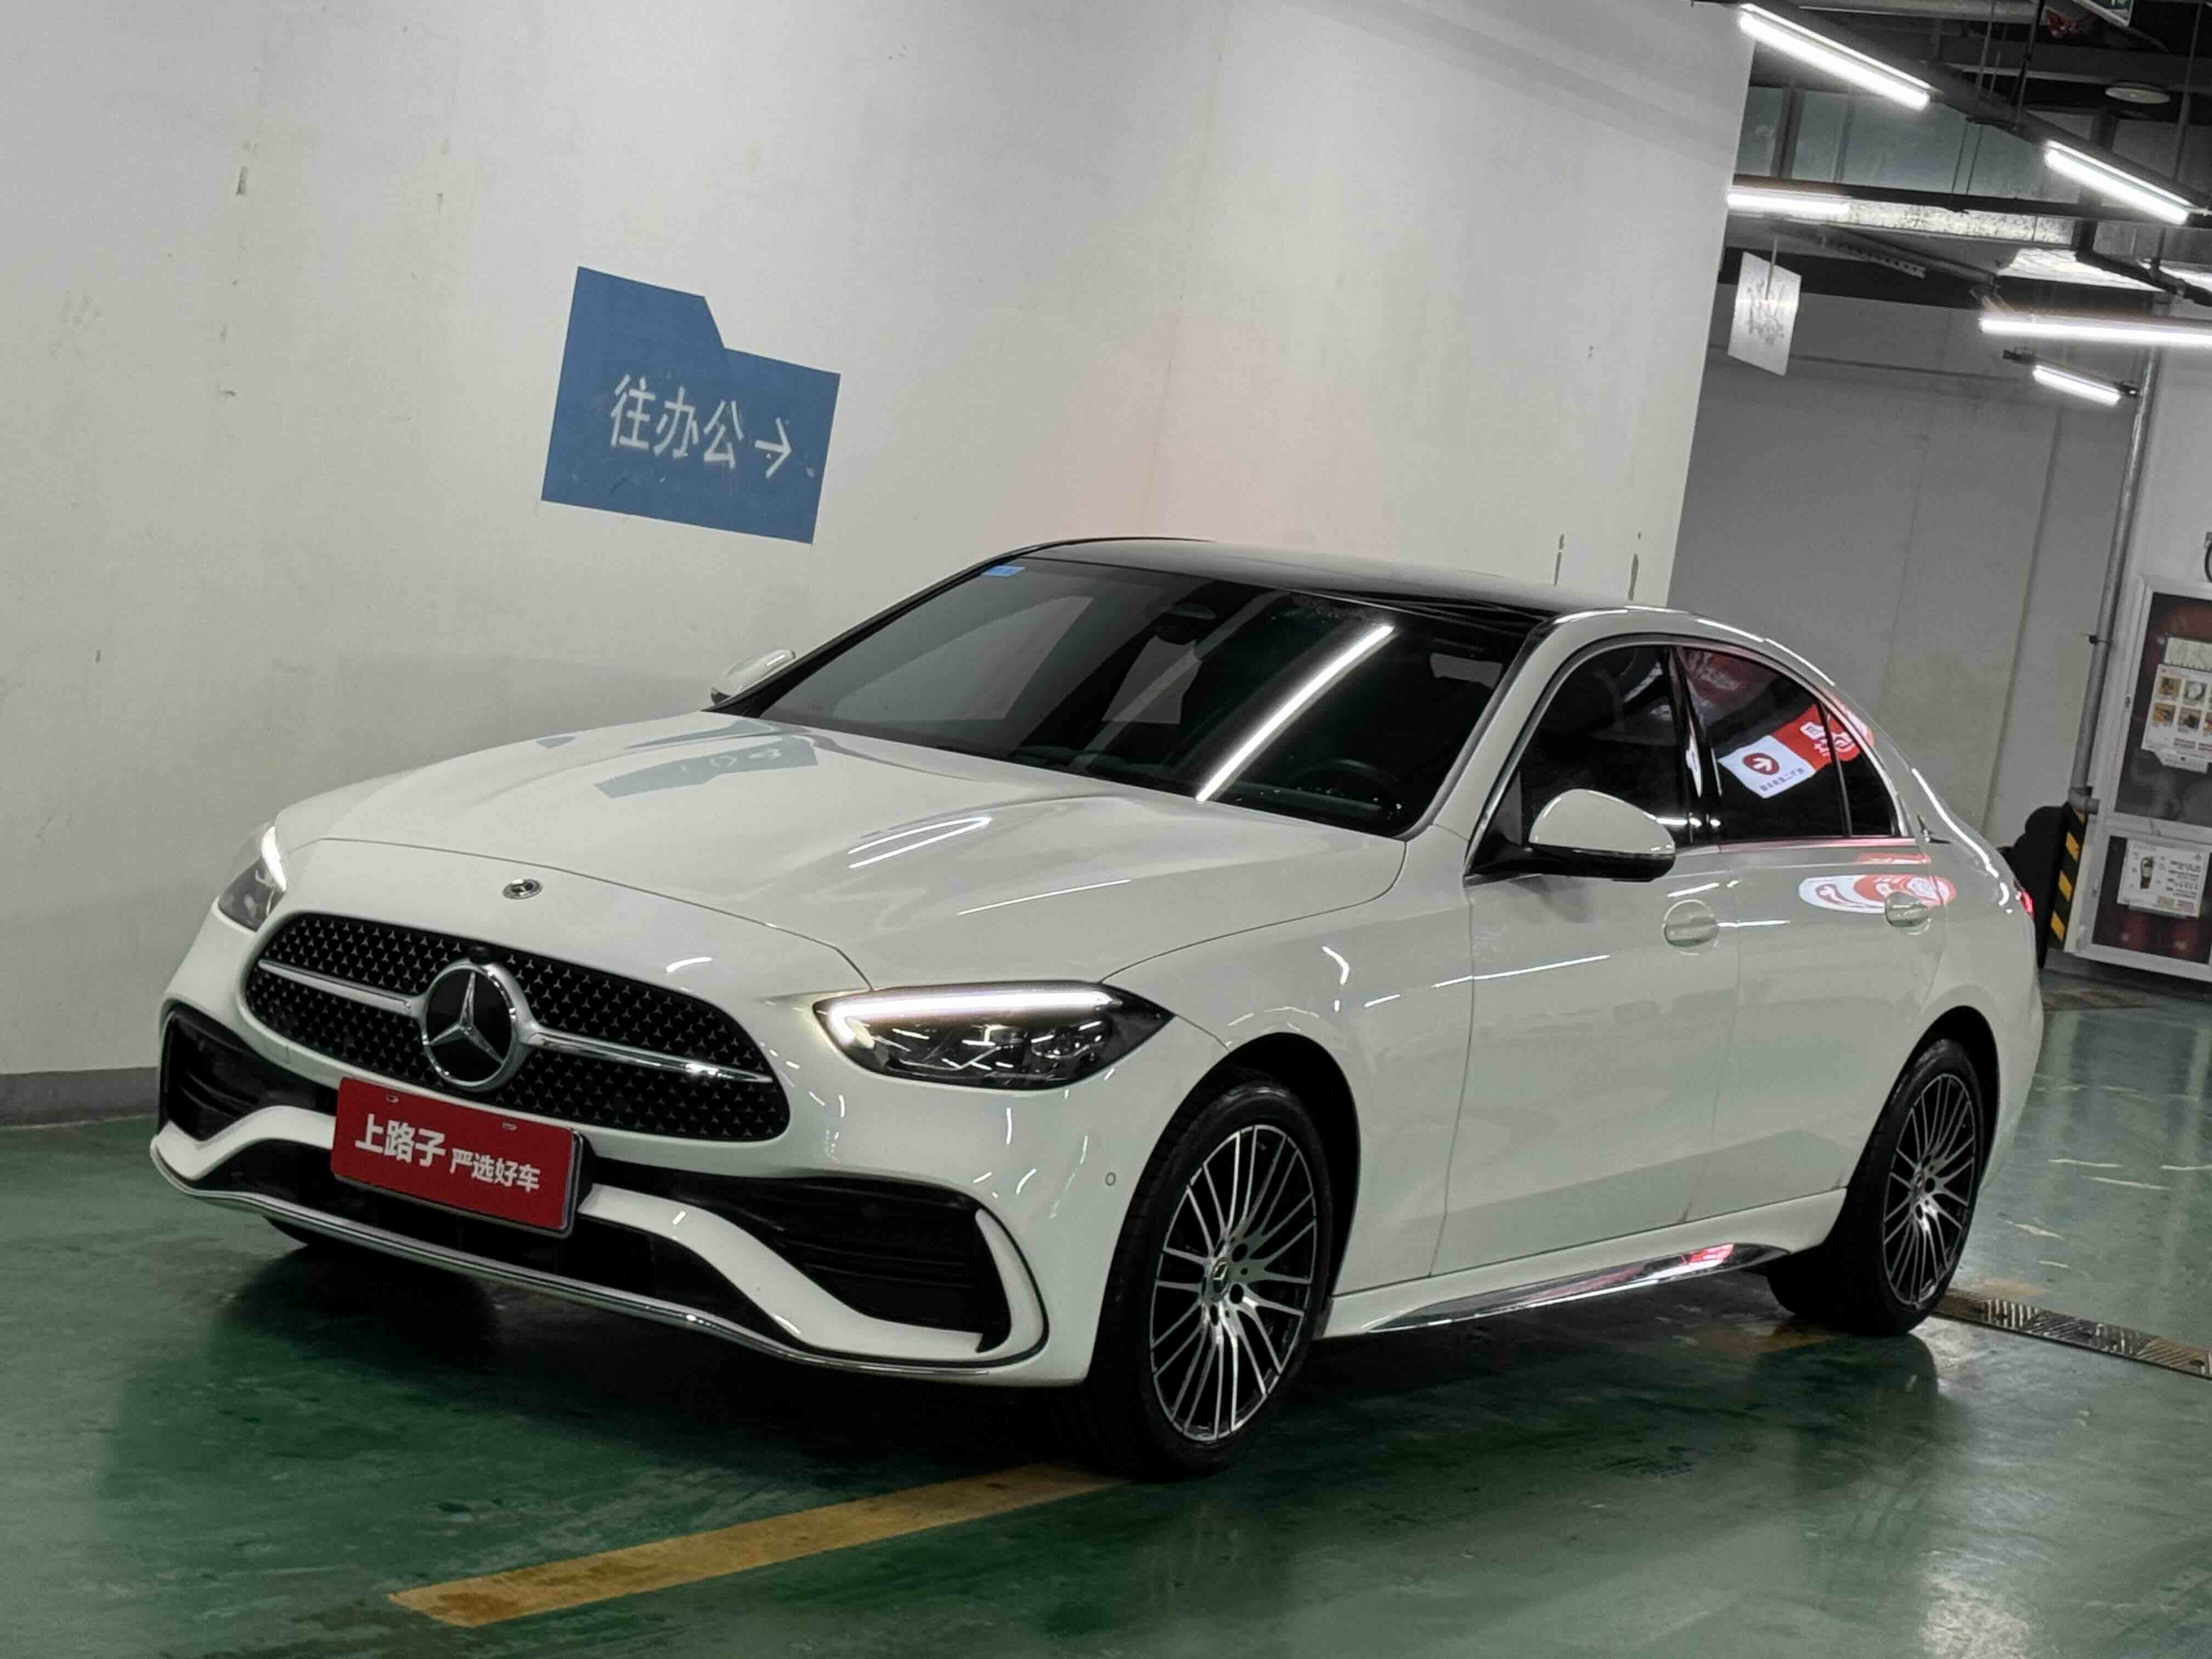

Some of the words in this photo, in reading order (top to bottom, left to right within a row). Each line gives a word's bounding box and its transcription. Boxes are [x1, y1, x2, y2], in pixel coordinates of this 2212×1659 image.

[611, 375, 743, 469] 往办公
[355, 1113, 446, 1167] 上路子
[449, 1148, 540, 1192] 严选好车
